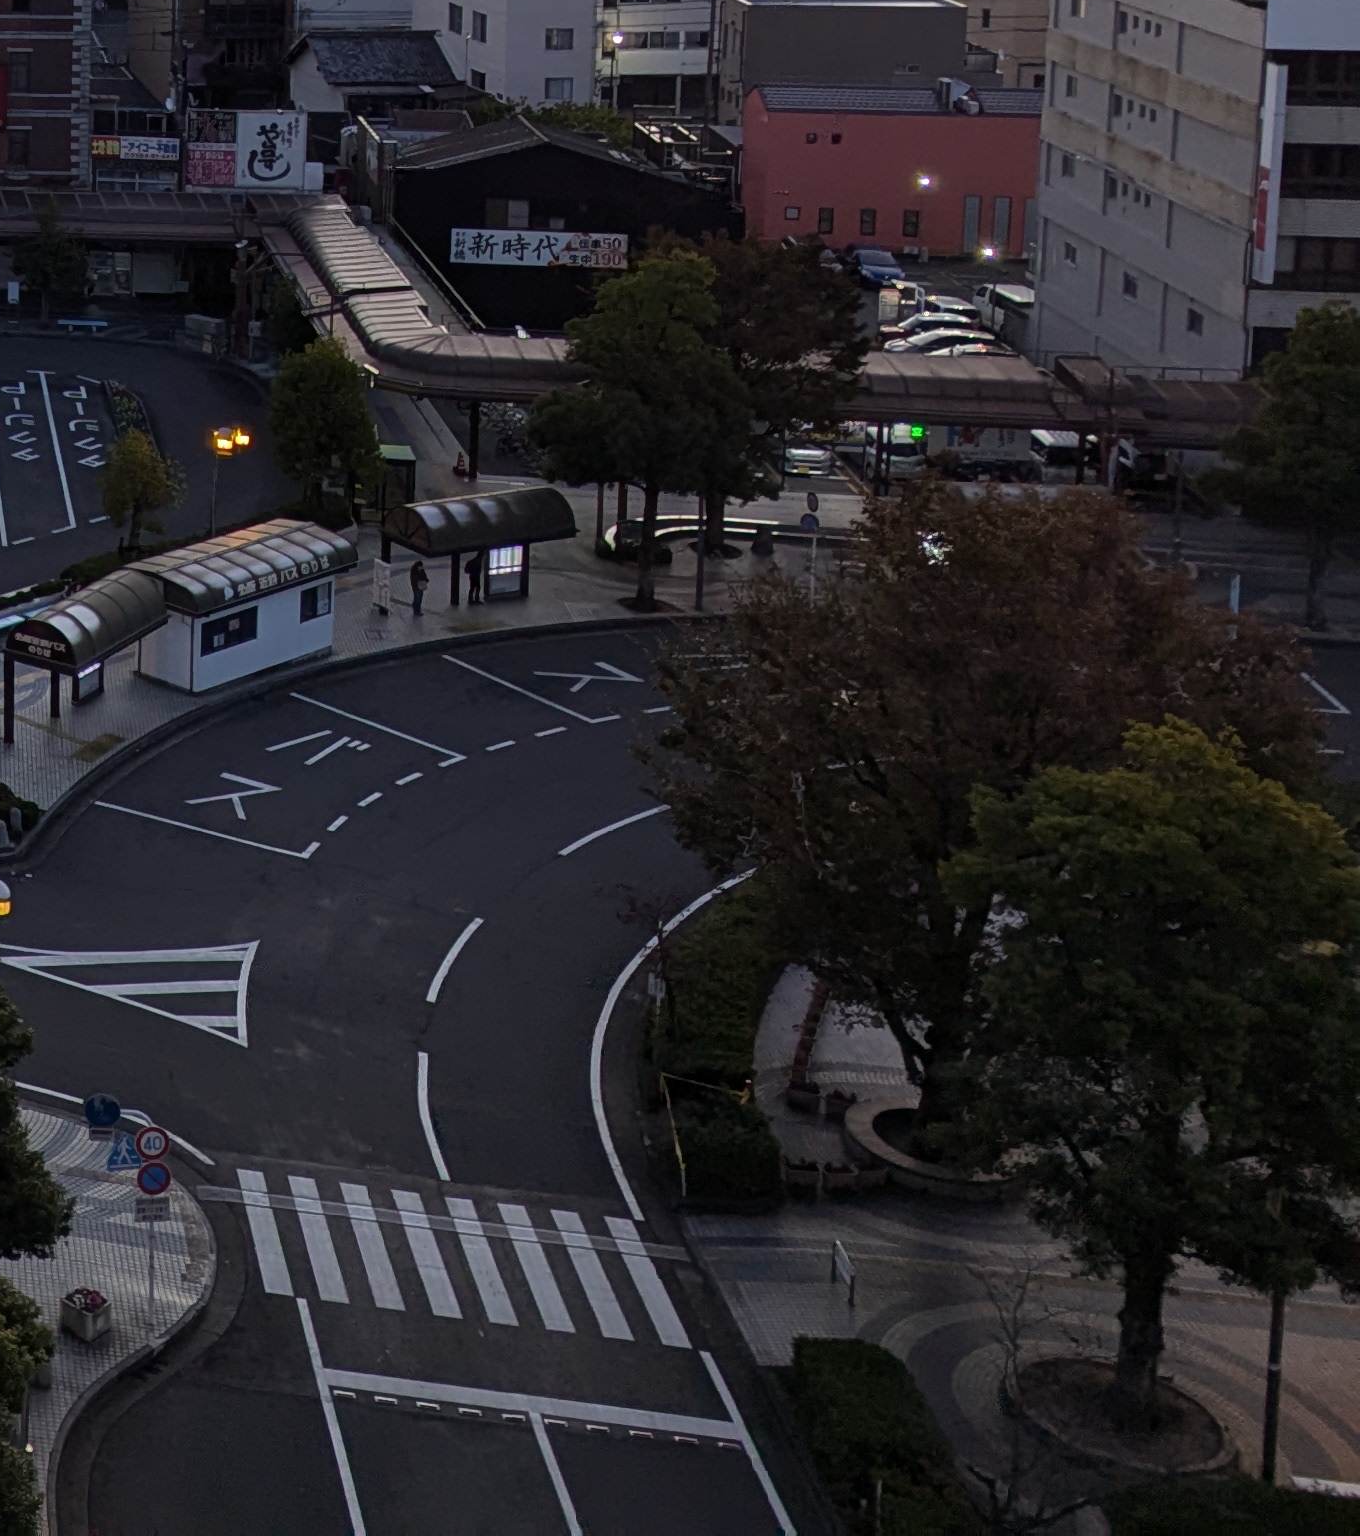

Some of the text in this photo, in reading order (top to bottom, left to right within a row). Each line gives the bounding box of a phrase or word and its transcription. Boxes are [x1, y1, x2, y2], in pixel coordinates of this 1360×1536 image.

[467, 232, 560, 262] 新時代
[185, 729, 372, 820] バス
[143, 1135, 162, 1151] 40
